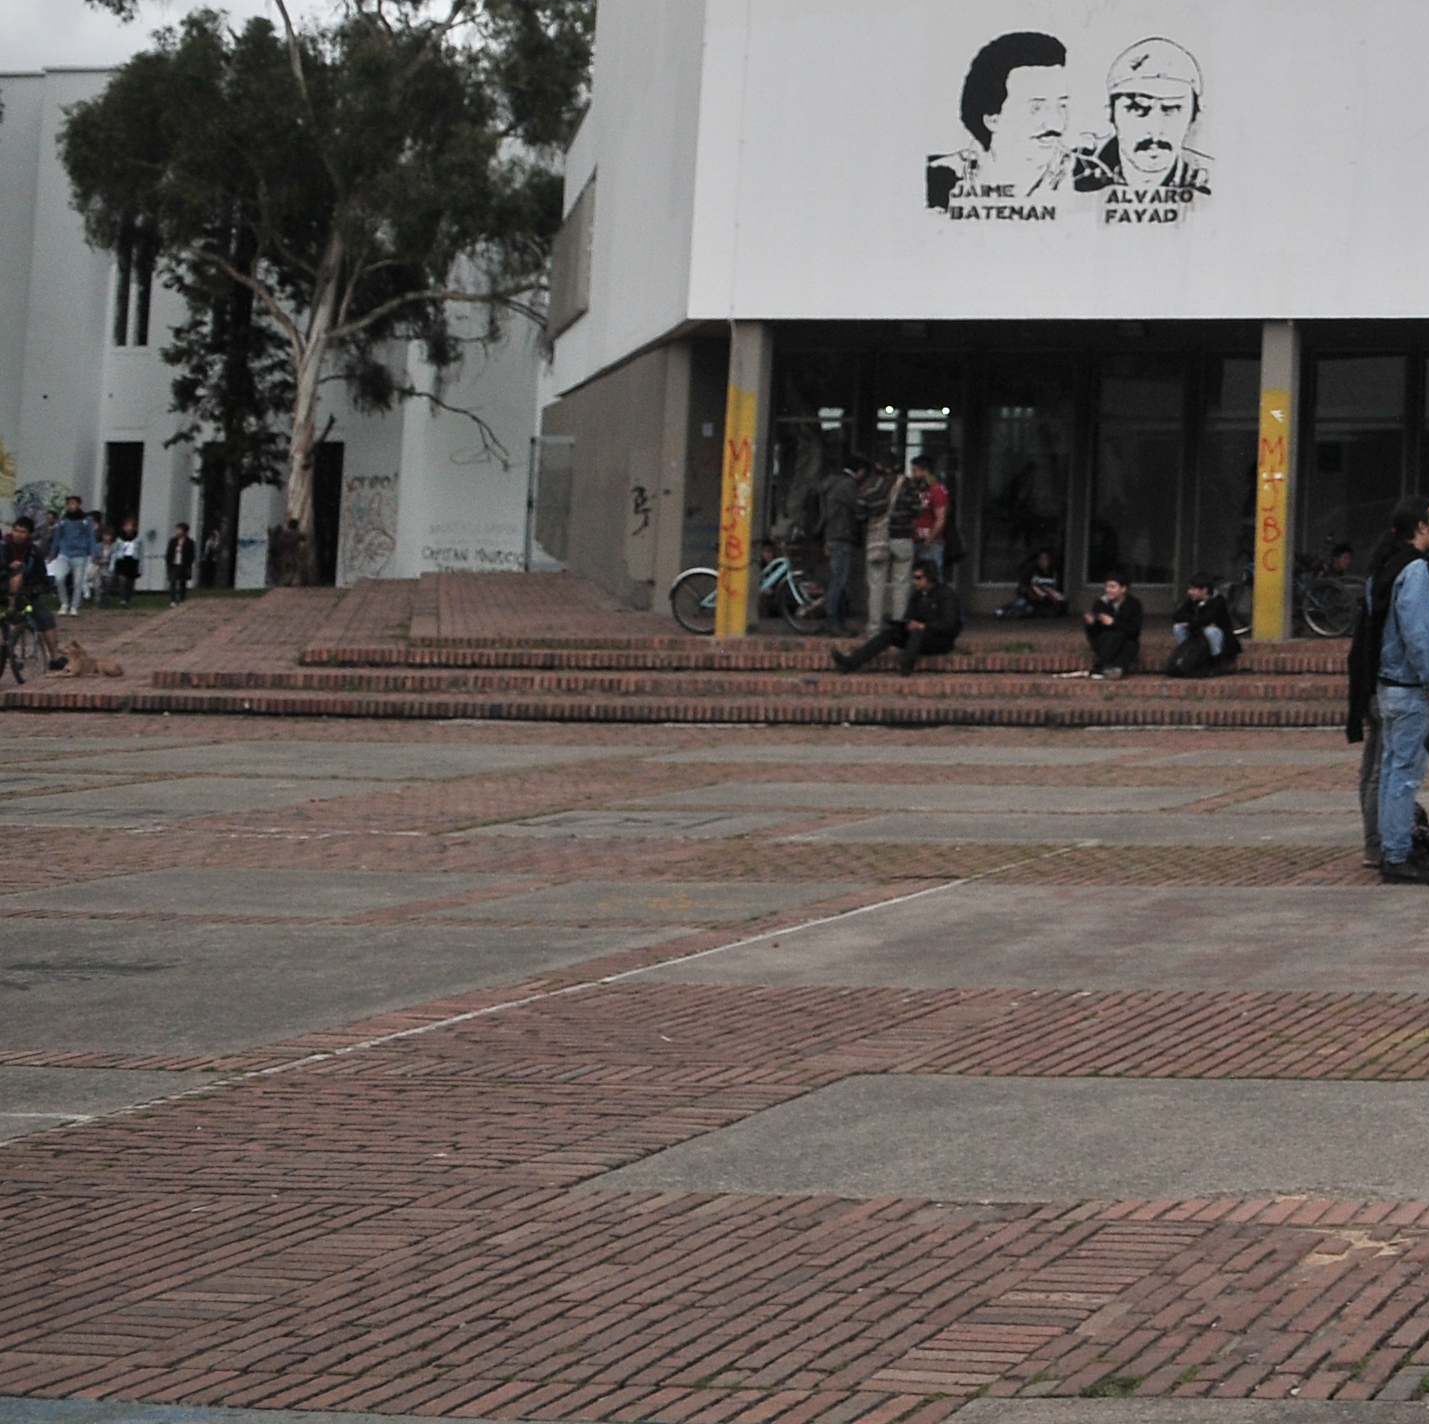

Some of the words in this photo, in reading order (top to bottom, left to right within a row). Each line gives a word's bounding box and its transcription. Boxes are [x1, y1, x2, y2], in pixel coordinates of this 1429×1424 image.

[950, 184, 1016, 199] JAIME
[1105, 188, 1194, 204] ALVARO
[950, 205, 1057, 221] BATEMAN
[1104, 208, 1179, 224] FAYAD
